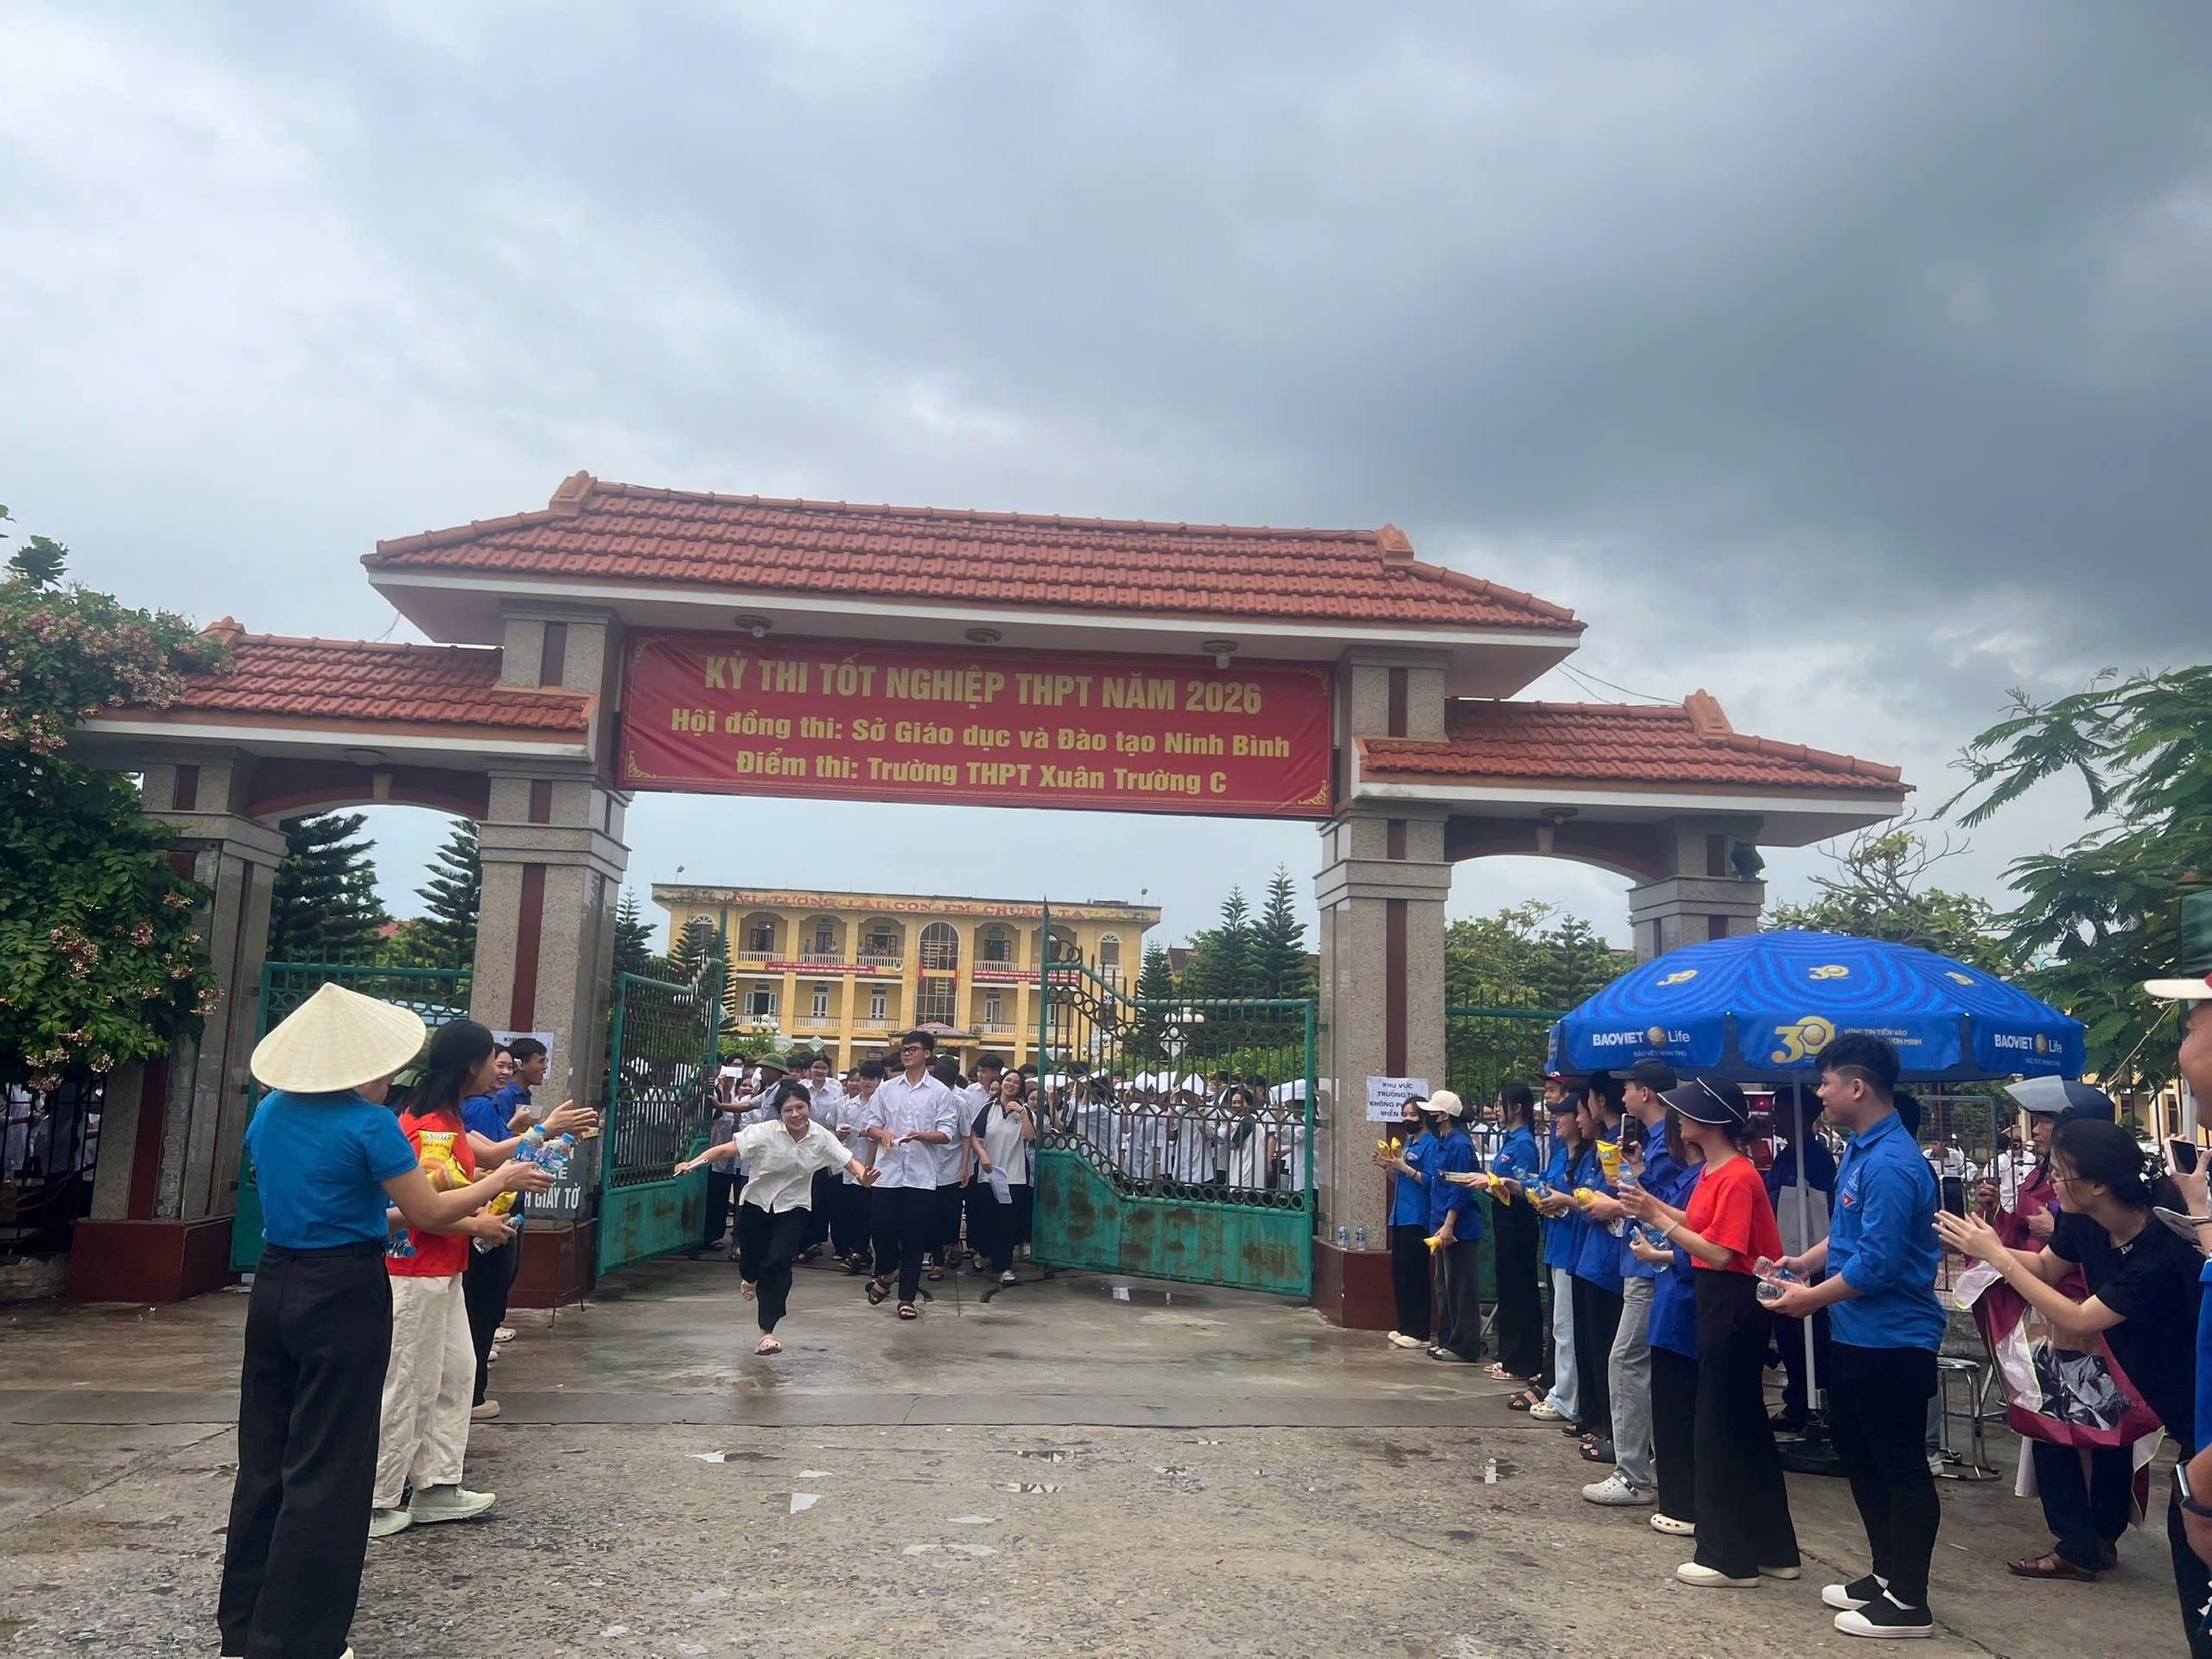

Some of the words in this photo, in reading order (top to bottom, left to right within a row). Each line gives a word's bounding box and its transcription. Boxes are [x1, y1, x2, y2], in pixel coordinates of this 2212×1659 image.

[705, 650, 747, 690] KỲ
[759, 660, 809, 693] THI
[820, 653, 876, 696] TỐT
[886, 664, 1005, 709] NGHIỆP
[1016, 673, 1093, 707] THPT
[1102, 671, 1176, 710] NĂM
[1185, 681, 1262, 715] 2026
[671, 708, 715, 737] Hội
[725, 709, 791, 740] đồng
[800, 716, 842, 740] thi:
[851, 717, 887, 743] Sở
[895, 721, 954, 746] Giáo
[963, 726, 1010, 752] dục
[1020, 727, 1049, 749] và
[1057, 728, 1107, 752] Đào
[1116, 731, 1155, 757] tạo
[1165, 732, 1224, 755] Ninh
[1232, 734, 1290, 758] Bình
[736, 747, 806, 776] Điểm
[815, 754, 858, 779] thi:
[868, 757, 958, 786] Trường
[966, 762, 1032, 787] THPT
[1039, 764, 1105, 790] Xuân
[1113, 767, 1202, 795] Trường
[1210, 771, 1227, 794] C
[893, 901, 932, 912] CON
[1668, 1030, 1690, 1043] Life
[563, 1181, 582, 1210] TỜ
